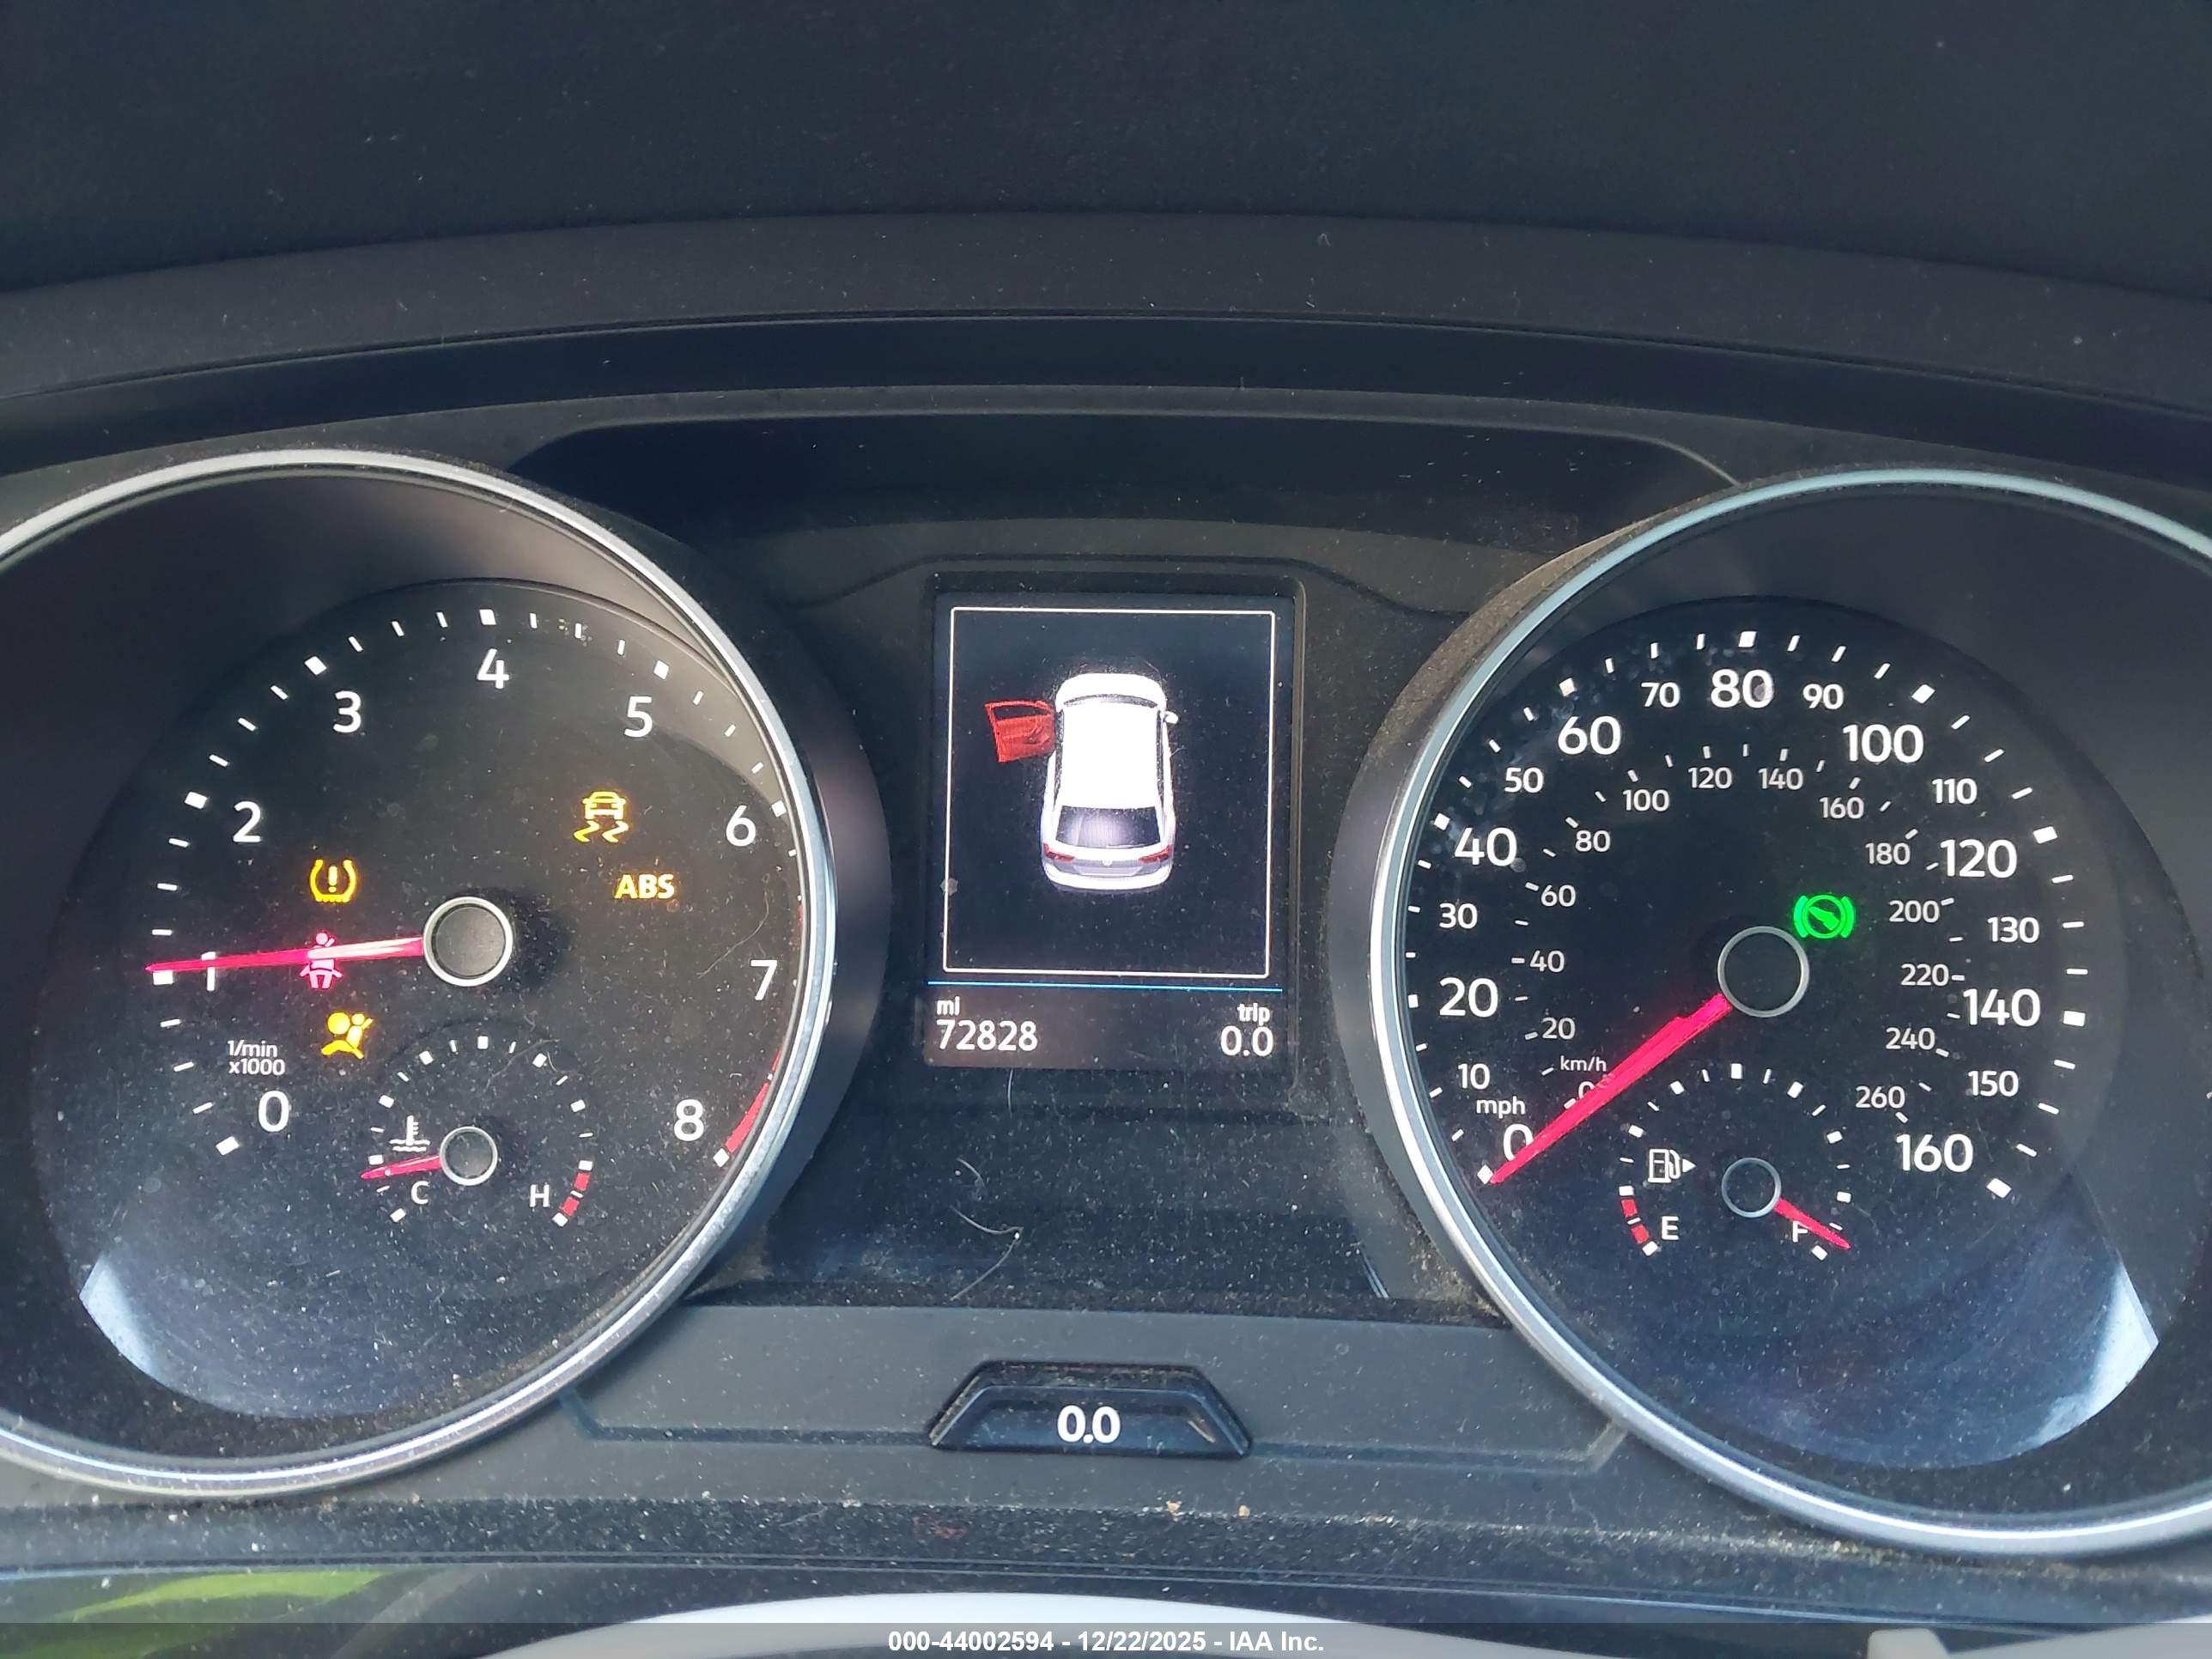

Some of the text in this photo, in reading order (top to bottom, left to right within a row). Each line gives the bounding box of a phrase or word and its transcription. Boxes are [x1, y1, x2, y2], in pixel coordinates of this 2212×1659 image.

[477, 648, 510, 690] 4
[1641, 682, 1680, 708] 70
[1711, 668, 1774, 708] 80
[1802, 684, 1844, 710] 90
[332, 690, 362, 733] 3
[624, 696, 653, 738] 5
[1558, 715, 1621, 756] 60
[1843, 724, 1924, 763] 100
[1504, 767, 1544, 793] 50
[1687, 767, 1733, 789] 120
[1758, 768, 1804, 790] 140
[1622, 788, 1670, 811] 100
[1931, 778, 1978, 805] 110
[1819, 796, 1864, 819] 160
[233, 800, 262, 843] 2
[726, 805, 757, 847] 6
[1454, 827, 1518, 867] 40
[1575, 830, 1611, 853] 80
[1865, 842, 1911, 866] 180
[1940, 838, 2018, 878] 120
[614, 873, 676, 899] ABS
[1540, 884, 1577, 907] 60
[1439, 902, 1478, 929] 30
[1888, 900, 1940, 923] 200
[1987, 916, 2040, 944] 130
[201, 951, 216, 991] 1
[1529, 950, 1565, 973] 40
[750, 959, 778, 1001] 7
[1900, 963, 1949, 987] 220
[936, 995, 961, 1016] mi
[1439, 976, 1498, 1018] 20
[1963, 988, 2041, 1027] 140
[1237, 1002, 1271, 1024] trip
[936, 1018, 1038, 1052] 72828
[1220, 1025, 1274, 1057] 0.0
[1542, 1017, 1576, 1040] 20
[1886, 1027, 1936, 1050] 240
[227, 1039, 278, 1058] 1/min
[228, 1058, 286, 1076] x1000
[1560, 1054, 1607, 1072] km/h
[1457, 1063, 1491, 1090] 10
[1967, 1070, 2019, 1097] 150
[1476, 1096, 1526, 1119] mph
[1855, 1085, 1905, 1109] 260
[258, 1090, 290, 1133] 0
[673, 1098, 706, 1142] 8
[1503, 1123, 1534, 1161] 0
[1896, 1133, 1974, 1173] 160
[410, 1180, 429, 1205] C
[529, 1182, 550, 1207] H
[1661, 1215, 1680, 1241] E
[1792, 1220, 1808, 1243] F
[1057, 1405, 1121, 1444] 0.0
